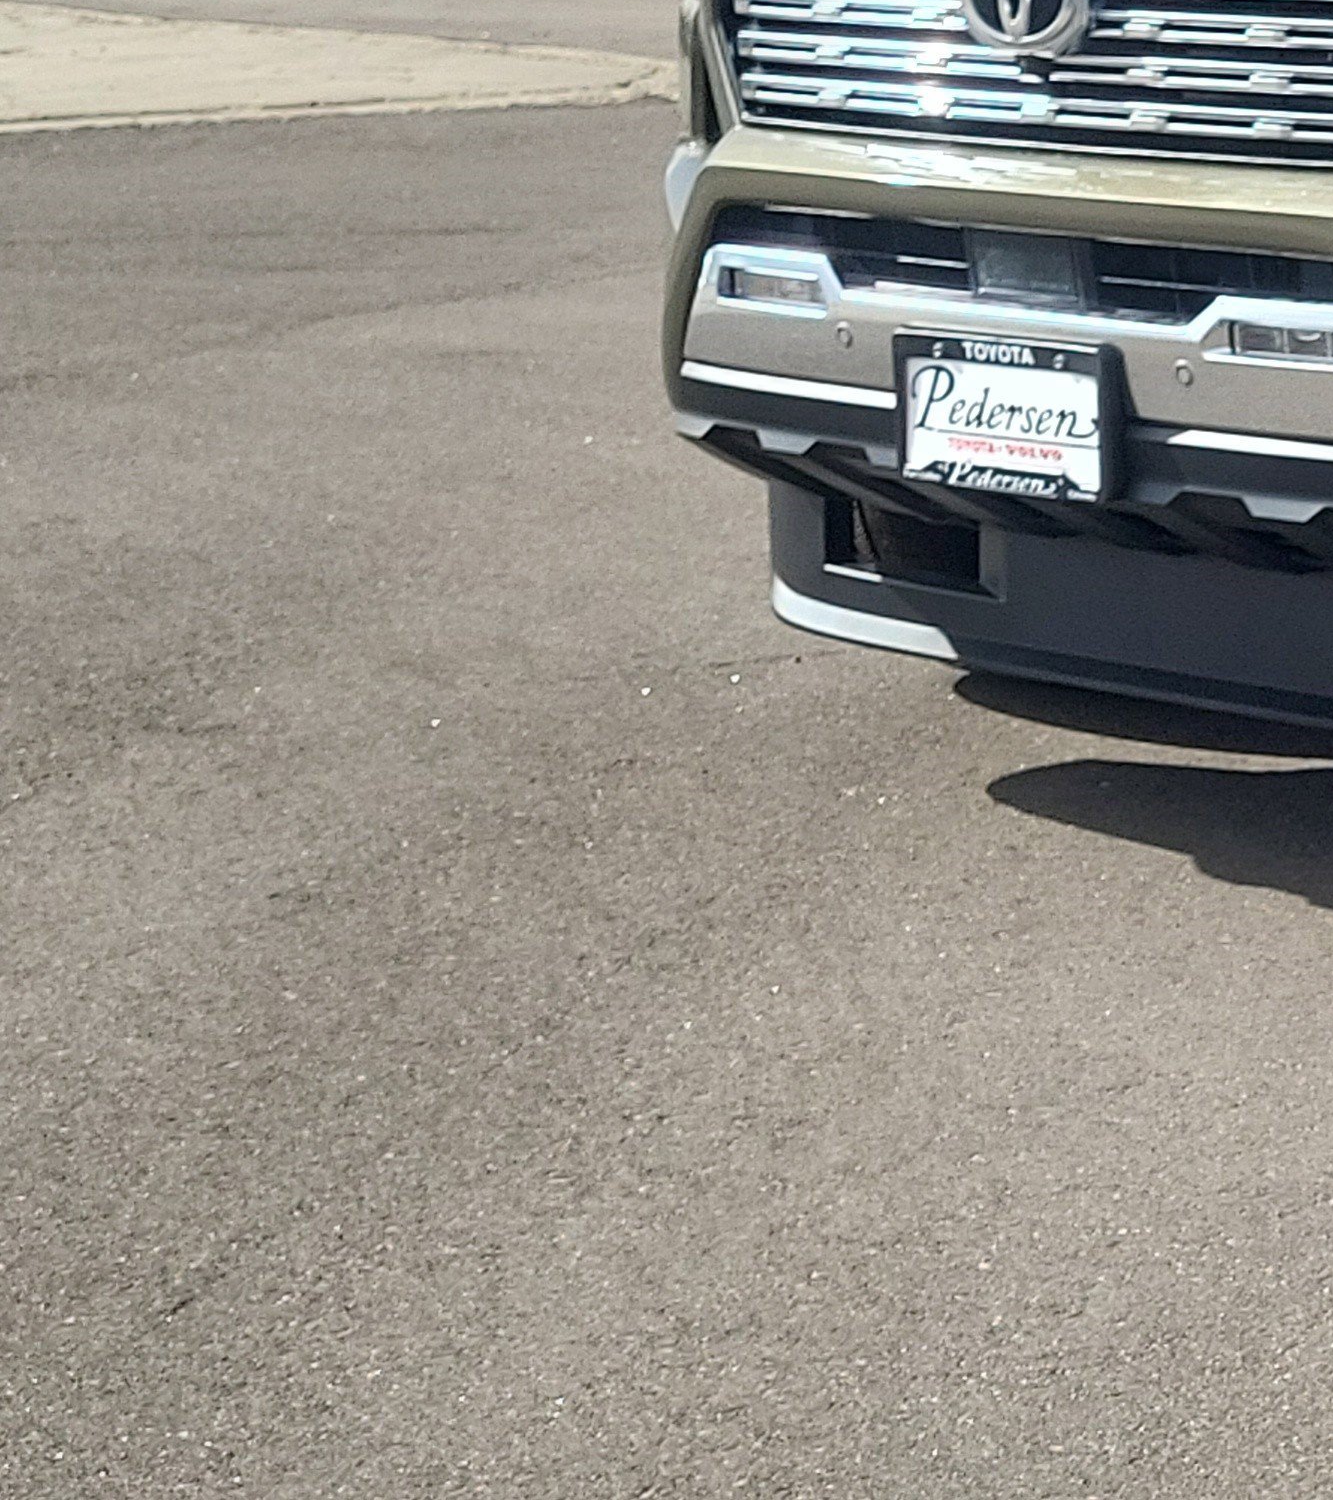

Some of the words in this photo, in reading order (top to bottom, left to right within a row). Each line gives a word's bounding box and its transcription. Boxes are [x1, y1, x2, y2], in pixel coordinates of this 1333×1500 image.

[962, 342, 1034, 364] TOYOTA
[912, 366, 1098, 438] Pedersen
[949, 461, 1058, 494] Pedersen
